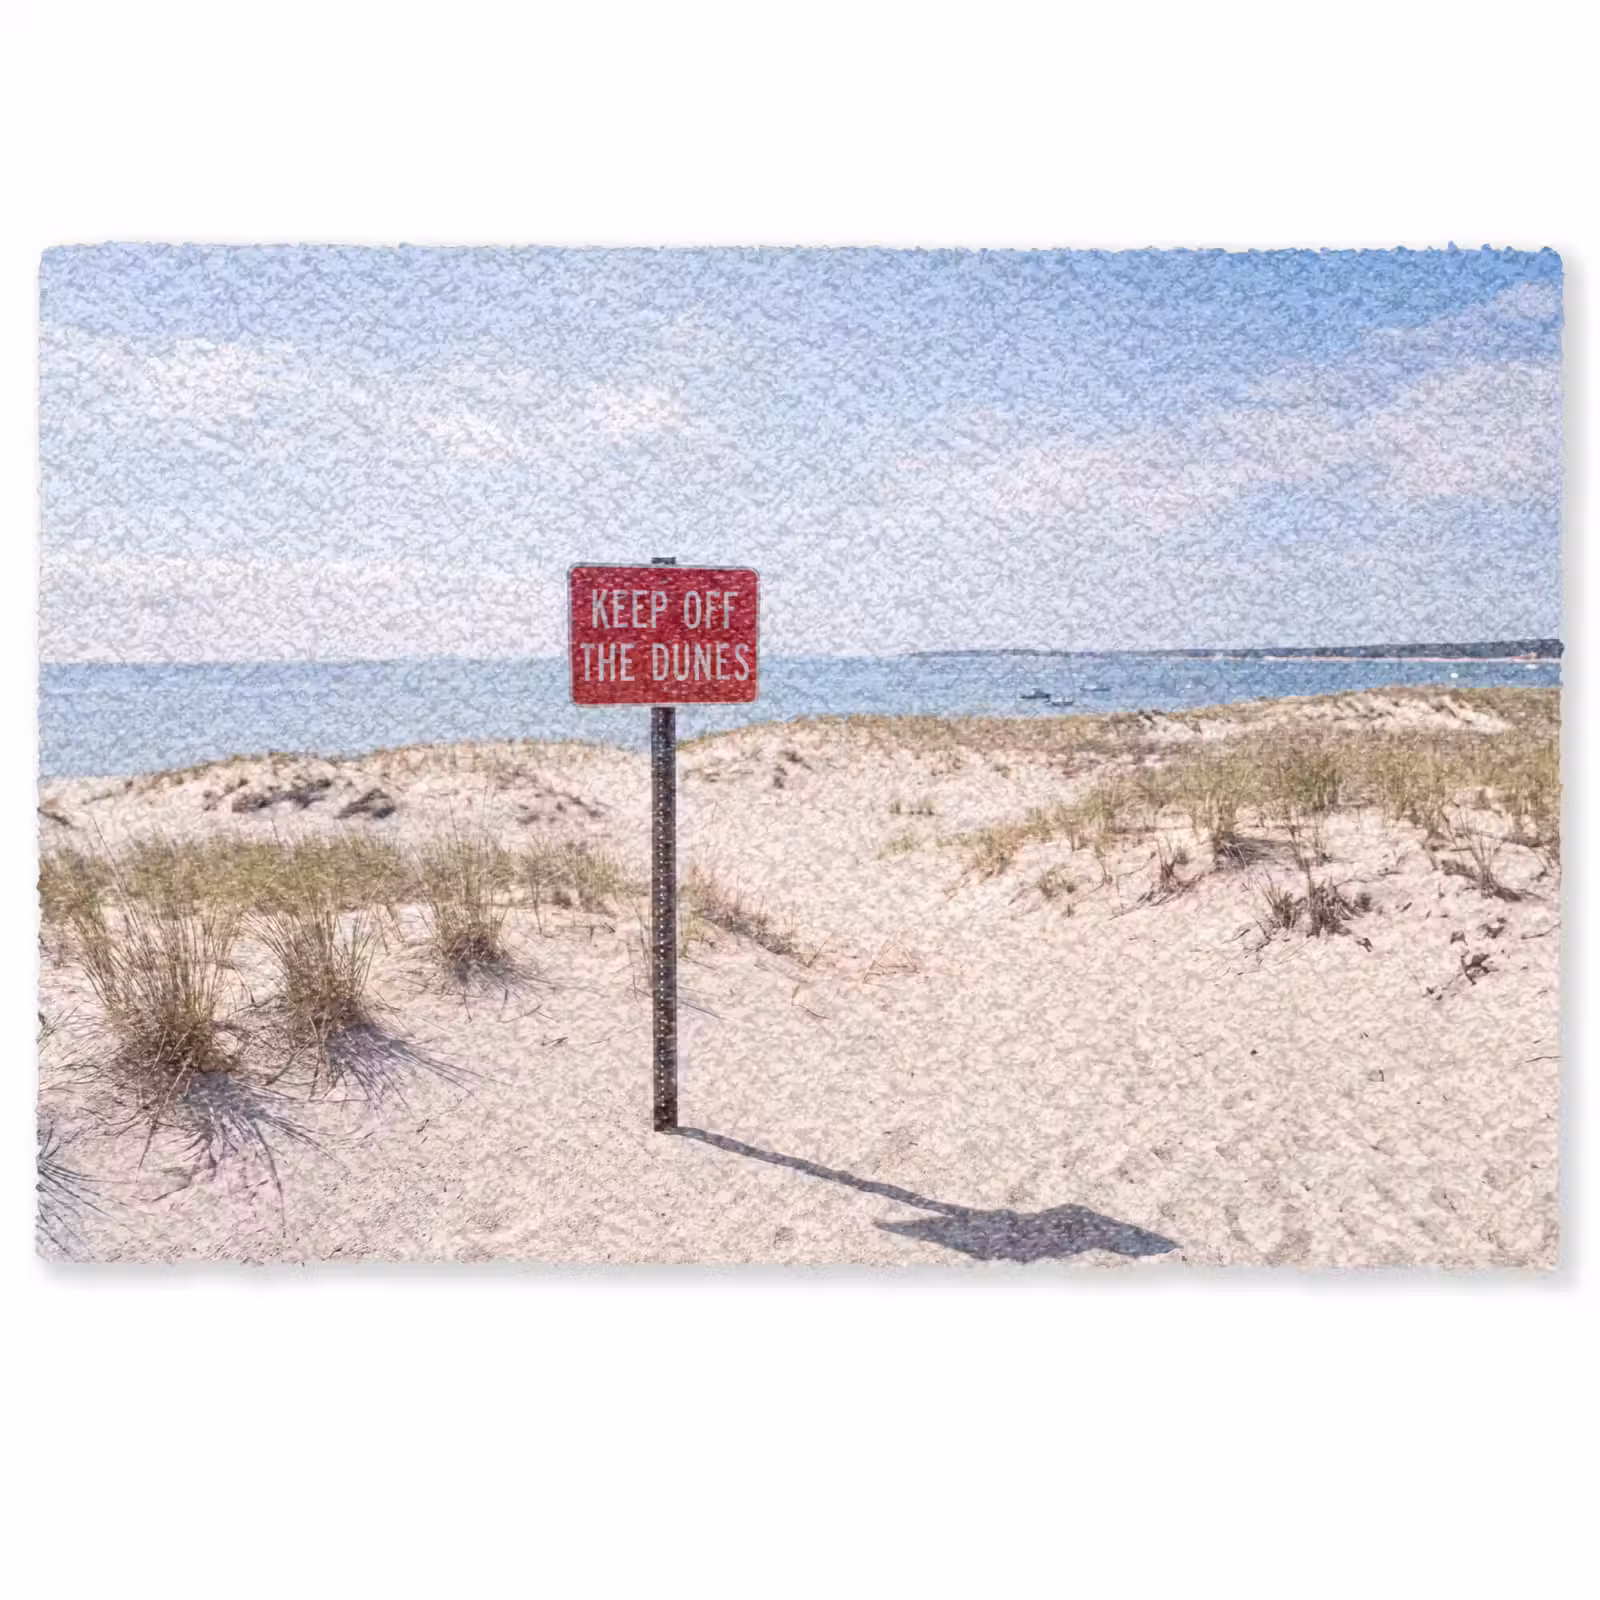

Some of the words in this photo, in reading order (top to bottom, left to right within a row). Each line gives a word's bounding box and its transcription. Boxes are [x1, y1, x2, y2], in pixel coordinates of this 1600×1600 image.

[591, 588, 668, 629] KEEP
[682, 589, 739, 629] OFF
[579, 642, 635, 682] THE
[651, 642, 750, 683] DUNES
